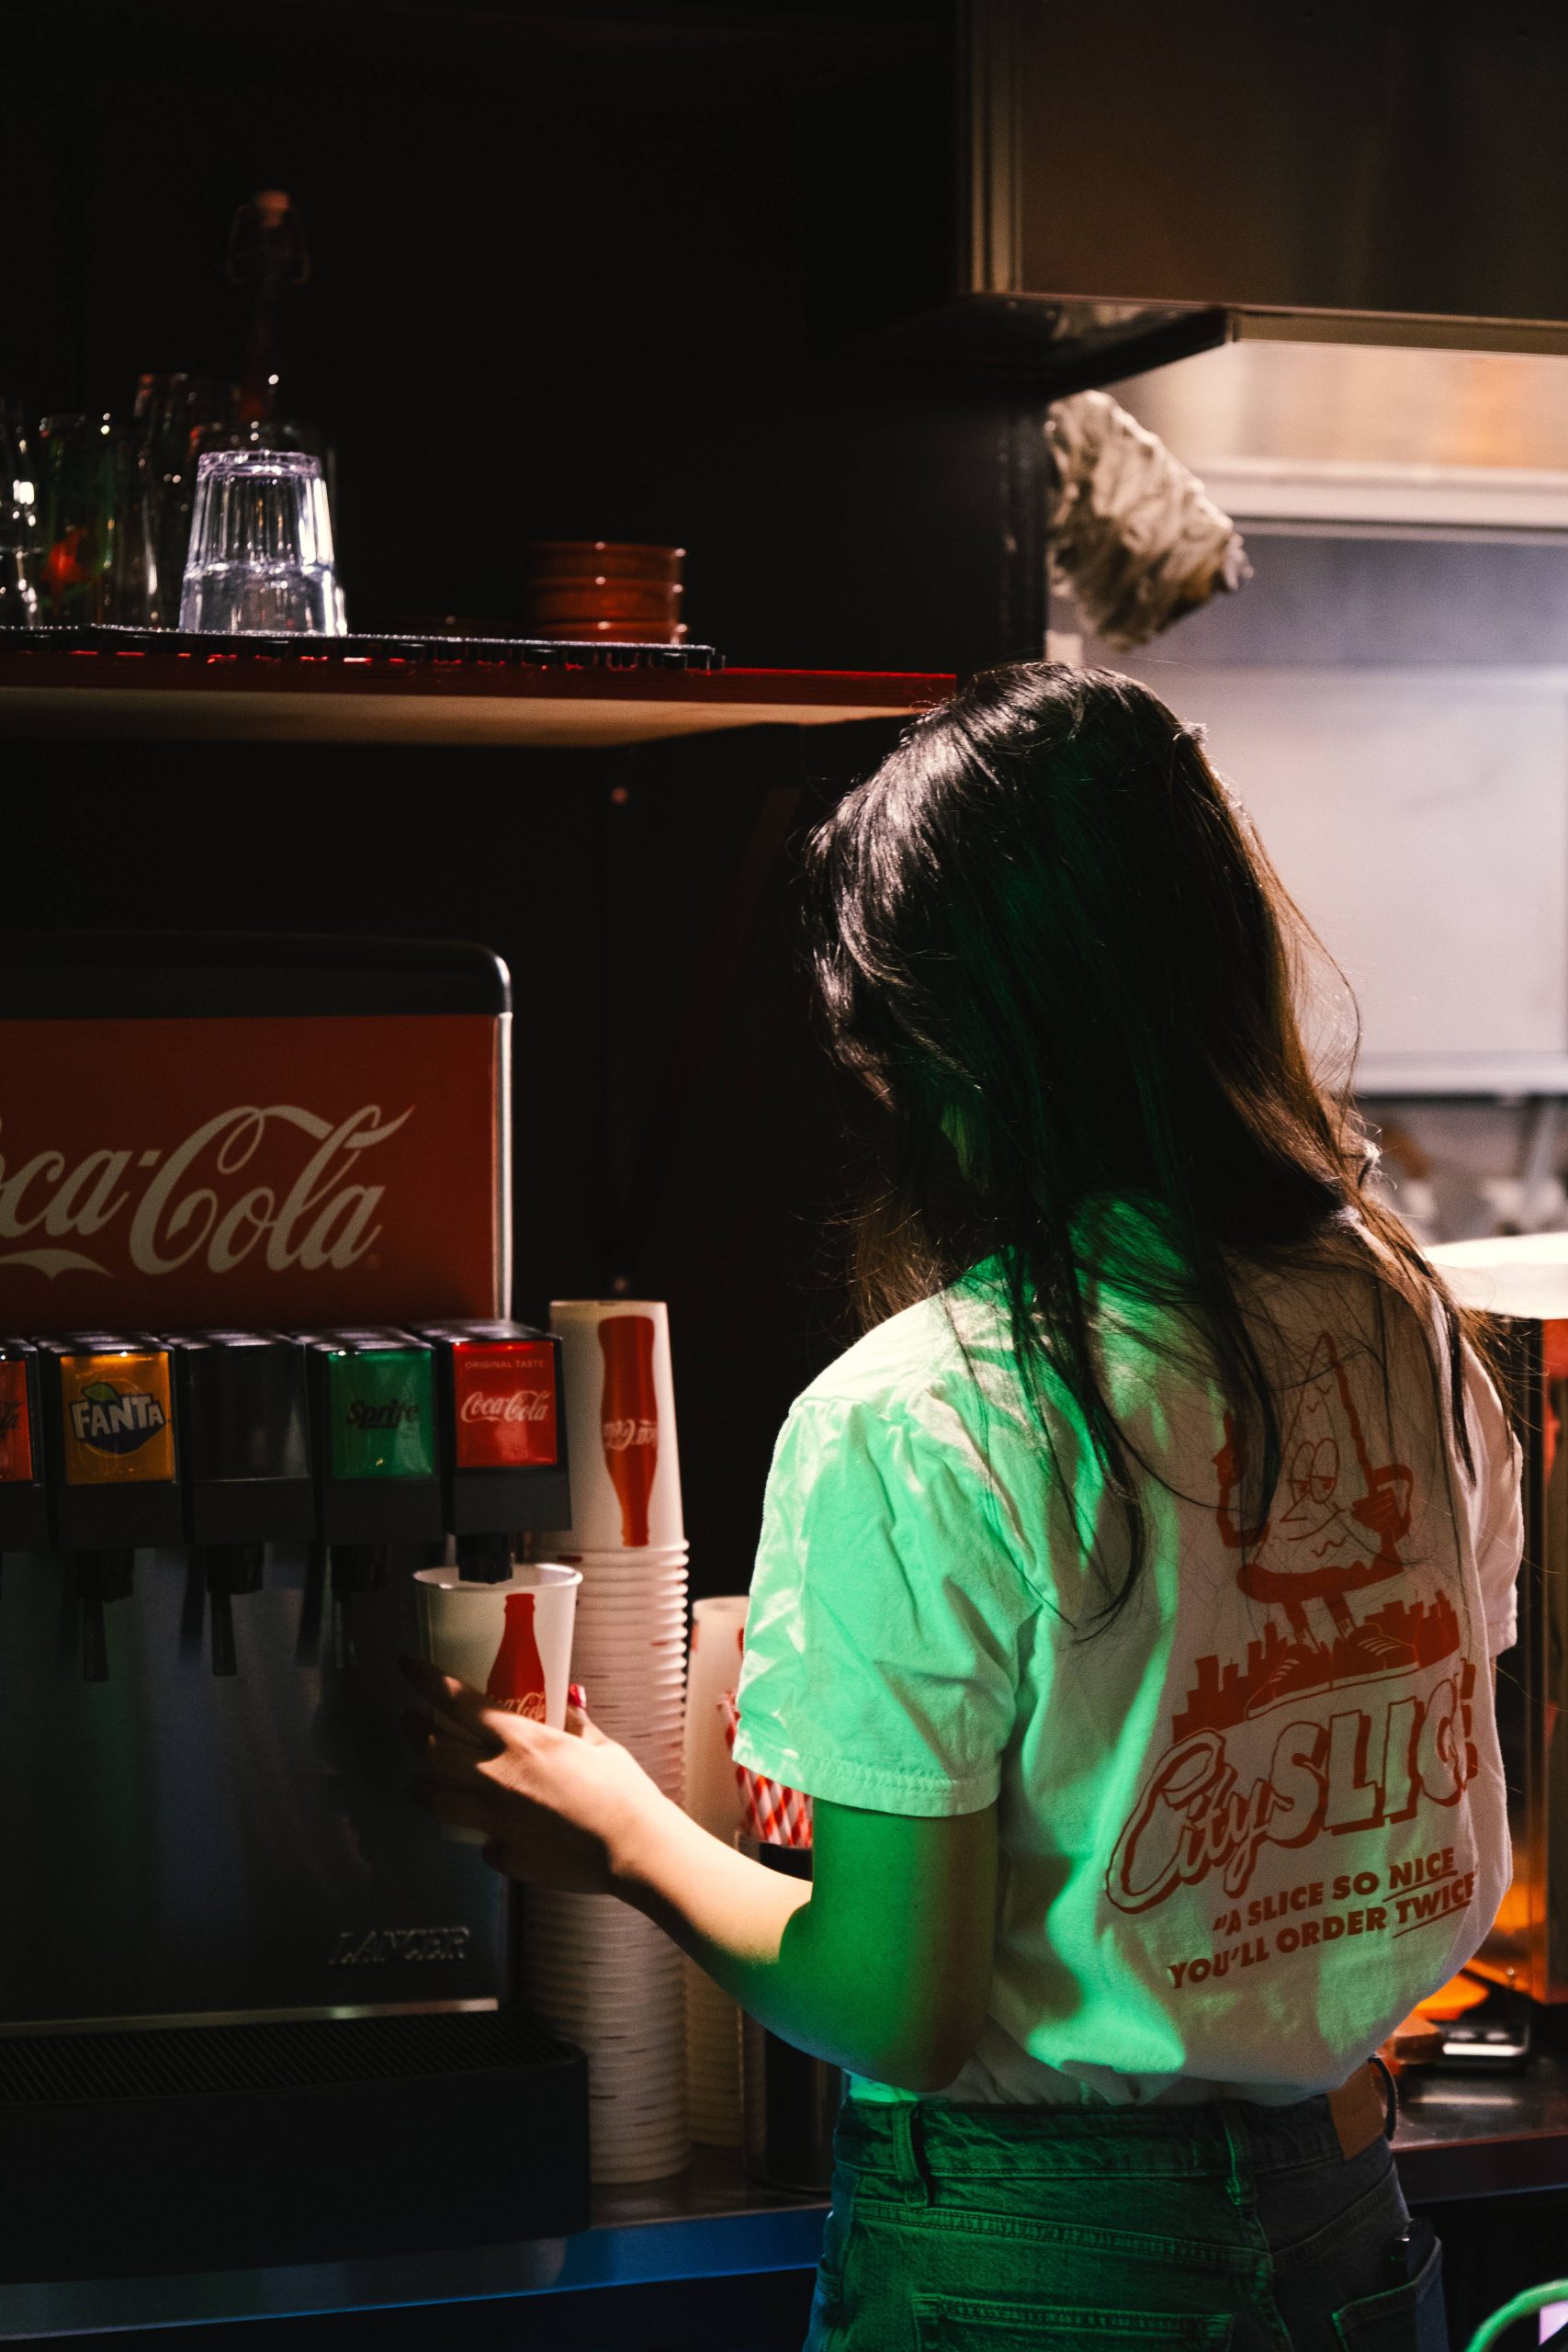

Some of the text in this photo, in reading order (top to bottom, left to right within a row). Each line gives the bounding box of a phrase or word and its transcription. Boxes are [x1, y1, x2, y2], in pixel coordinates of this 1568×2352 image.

[0, 1104, 415, 1277] ca-Cola
[465, 1359, 546, 1370] ORIGINAL TASTE
[70, 1394, 164, 1440] FANTA
[348, 1398, 420, 1430] Sprite
[460, 1390, 552, 1423] Coca-Cola
[1105, 1727, 1275, 1914] City
[1247, 1882, 1325, 1928] SLICE
[1332, 1871, 1381, 1901] SO
[1389, 1847, 1455, 1890] NICE
[1168, 1871, 1476, 1989] YOU'LL ORDER TWICE
